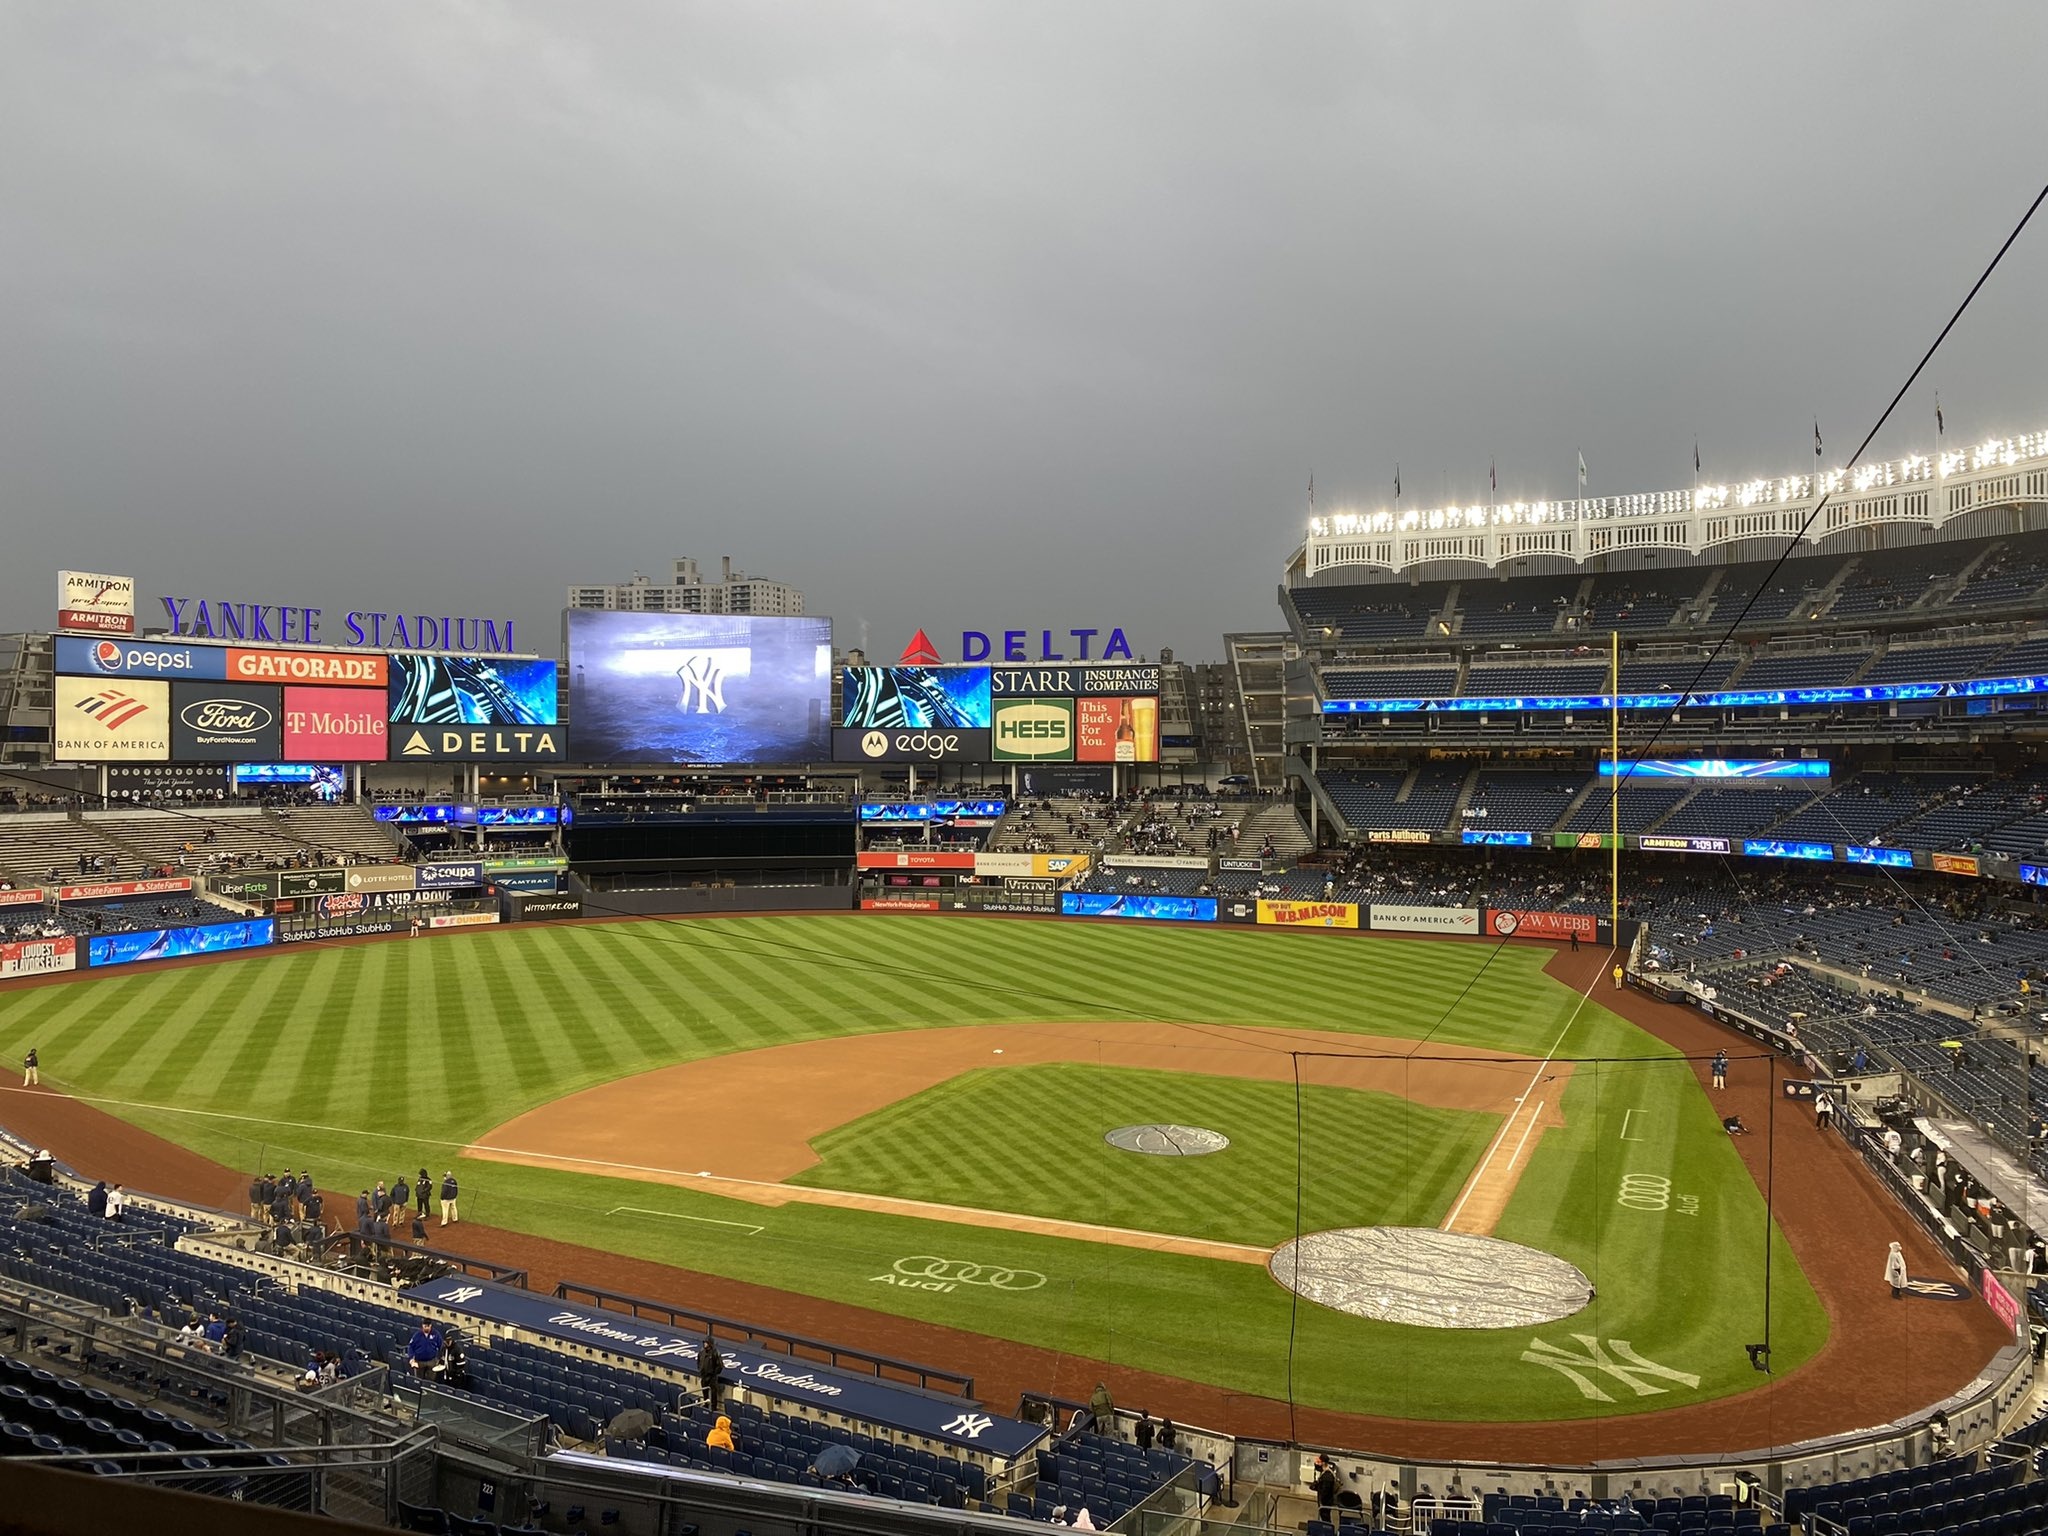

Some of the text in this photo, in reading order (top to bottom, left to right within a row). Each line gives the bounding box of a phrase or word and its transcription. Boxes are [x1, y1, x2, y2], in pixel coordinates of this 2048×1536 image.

[67, 577, 130, 591] ARMITRON
[70, 612, 128, 625] ARMITRON
[98, 622, 126, 630] WATCHES
[164, 597, 514, 653] YANKEE STADIUM
[962, 628, 1133, 662] DELTA
[127, 650, 190, 671] pepsi
[238, 655, 377, 680] GATORADE
[1085, 668, 1159, 681] INSURANCE
[992, 671, 1076, 692] STARR
[1084, 680, 1159, 692] COMPANIES
[1081, 702, 1107, 712] This
[197, 703, 257, 729] Ford
[1081, 713, 1113, 724] Bud's
[310, 712, 385, 735] Mobile
[1001, 720, 1066, 738] HESS
[1081, 725, 1101, 735] For
[57, 740, 165, 750] BANK OF AMERICA
[197, 737, 256, 745] BuyFordNow.com
[442, 732, 557, 753] DELTA
[895, 730, 959, 760] edge
[1081, 736, 1106, 746] You.
[1724, 778, 1767, 786] CLUBHOUSE
[1369, 831, 1391, 839] Parts
[1392, 830, 1431, 841] Authority
[1643, 838, 1688, 848] ARMITRON
[1048, 860, 1067, 871] SAP
[388, 874, 413, 882] HOTELS
[438, 866, 475, 881] coupa
[960, 875, 981, 883] FedEx
[221, 882, 268, 894] Uber Eats
[524, 902, 579, 913] NITTOTIRE.COM
[1033, 905, 1056, 913] StubHub
[1373, 914, 1398, 922] BANK
[1413, 916, 1455, 924] AMERICA
[1520, 914, 1591, 931] F.W. WEBB
[318, 926, 353, 938] StubHub
[356, 923, 392, 935] StubHub
[282, 931, 316, 942] StubHub
[21, 943, 57, 960] LOUDEST
[12, 957, 46, 972] FLAVORS
[1676, 1193, 1700, 1217] Audi
[868, 1272, 959, 1294] Audi
[548, 1312, 638, 1342] Welcome
[635, 1336, 661, 1347] to
[741, 1363, 843, 1397] Stadium
